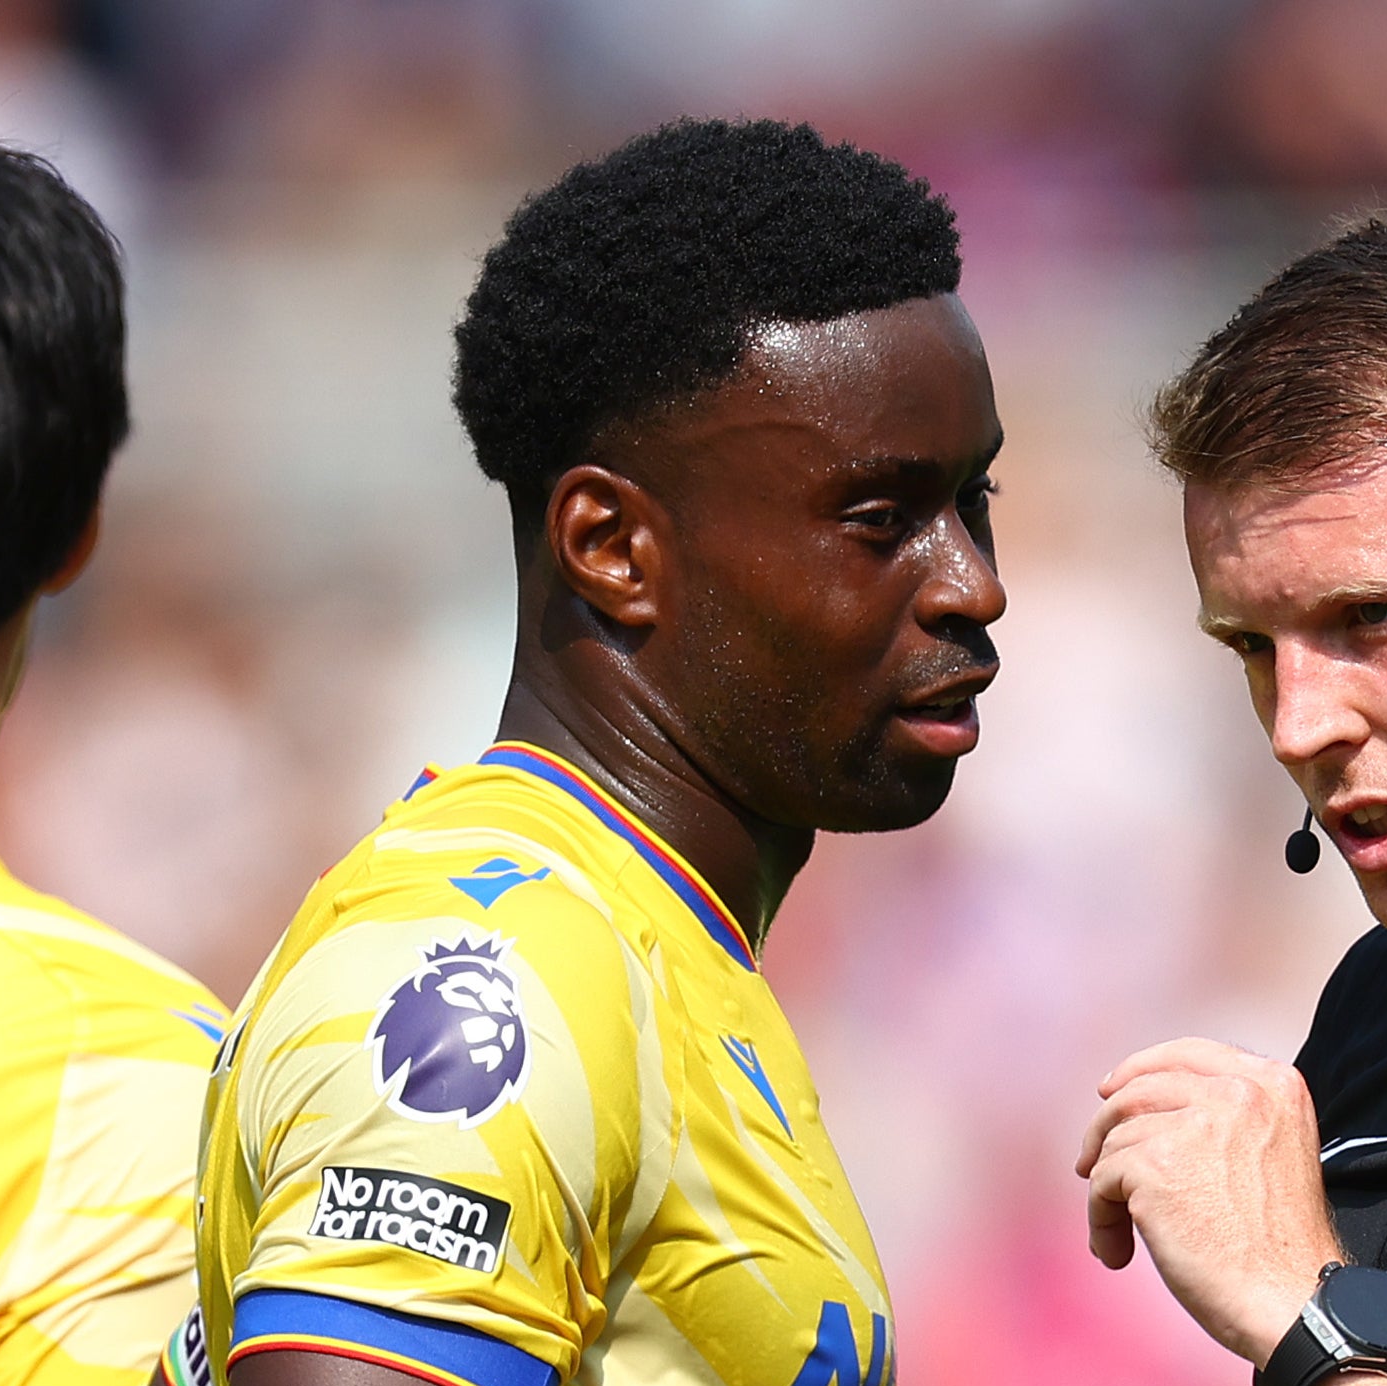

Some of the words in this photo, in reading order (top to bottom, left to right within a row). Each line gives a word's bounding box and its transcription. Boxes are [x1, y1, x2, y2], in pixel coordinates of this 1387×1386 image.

[322, 1168, 374, 1207] No
[375, 1178, 489, 1236] room
[310, 1202, 365, 1239] for
[364, 1210, 497, 1273] racism
